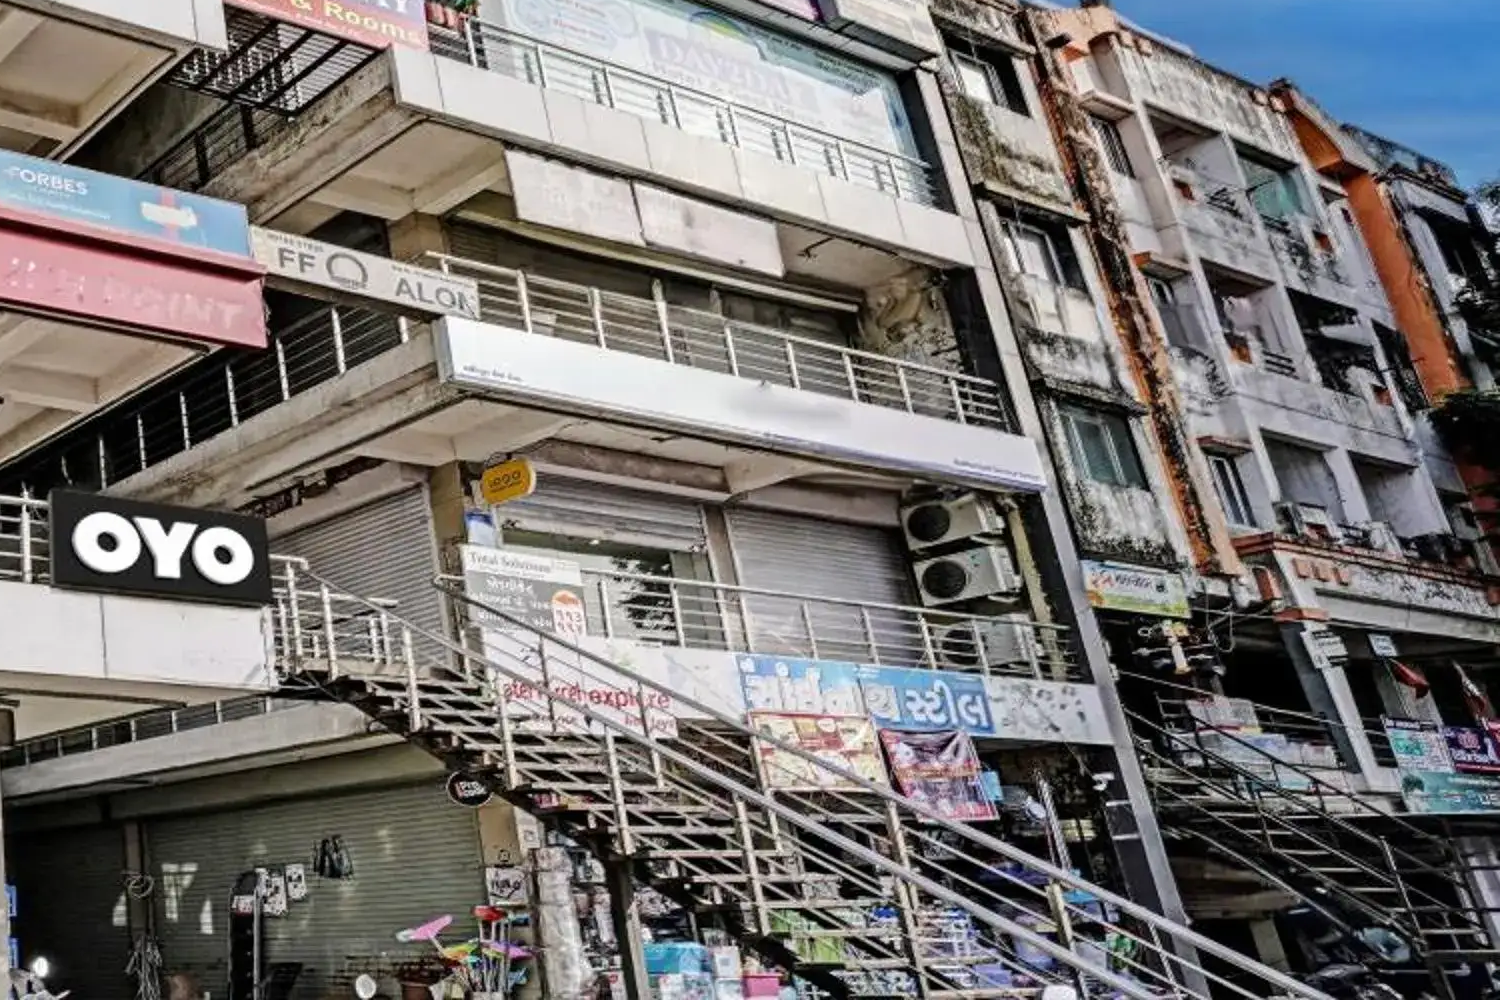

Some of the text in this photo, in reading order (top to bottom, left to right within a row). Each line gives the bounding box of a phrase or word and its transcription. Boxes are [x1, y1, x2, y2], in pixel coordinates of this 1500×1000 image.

[324, 0, 422, 43] Rooms
[3, 166, 88, 195] FORBES
[72, 511, 255, 585] OYO
